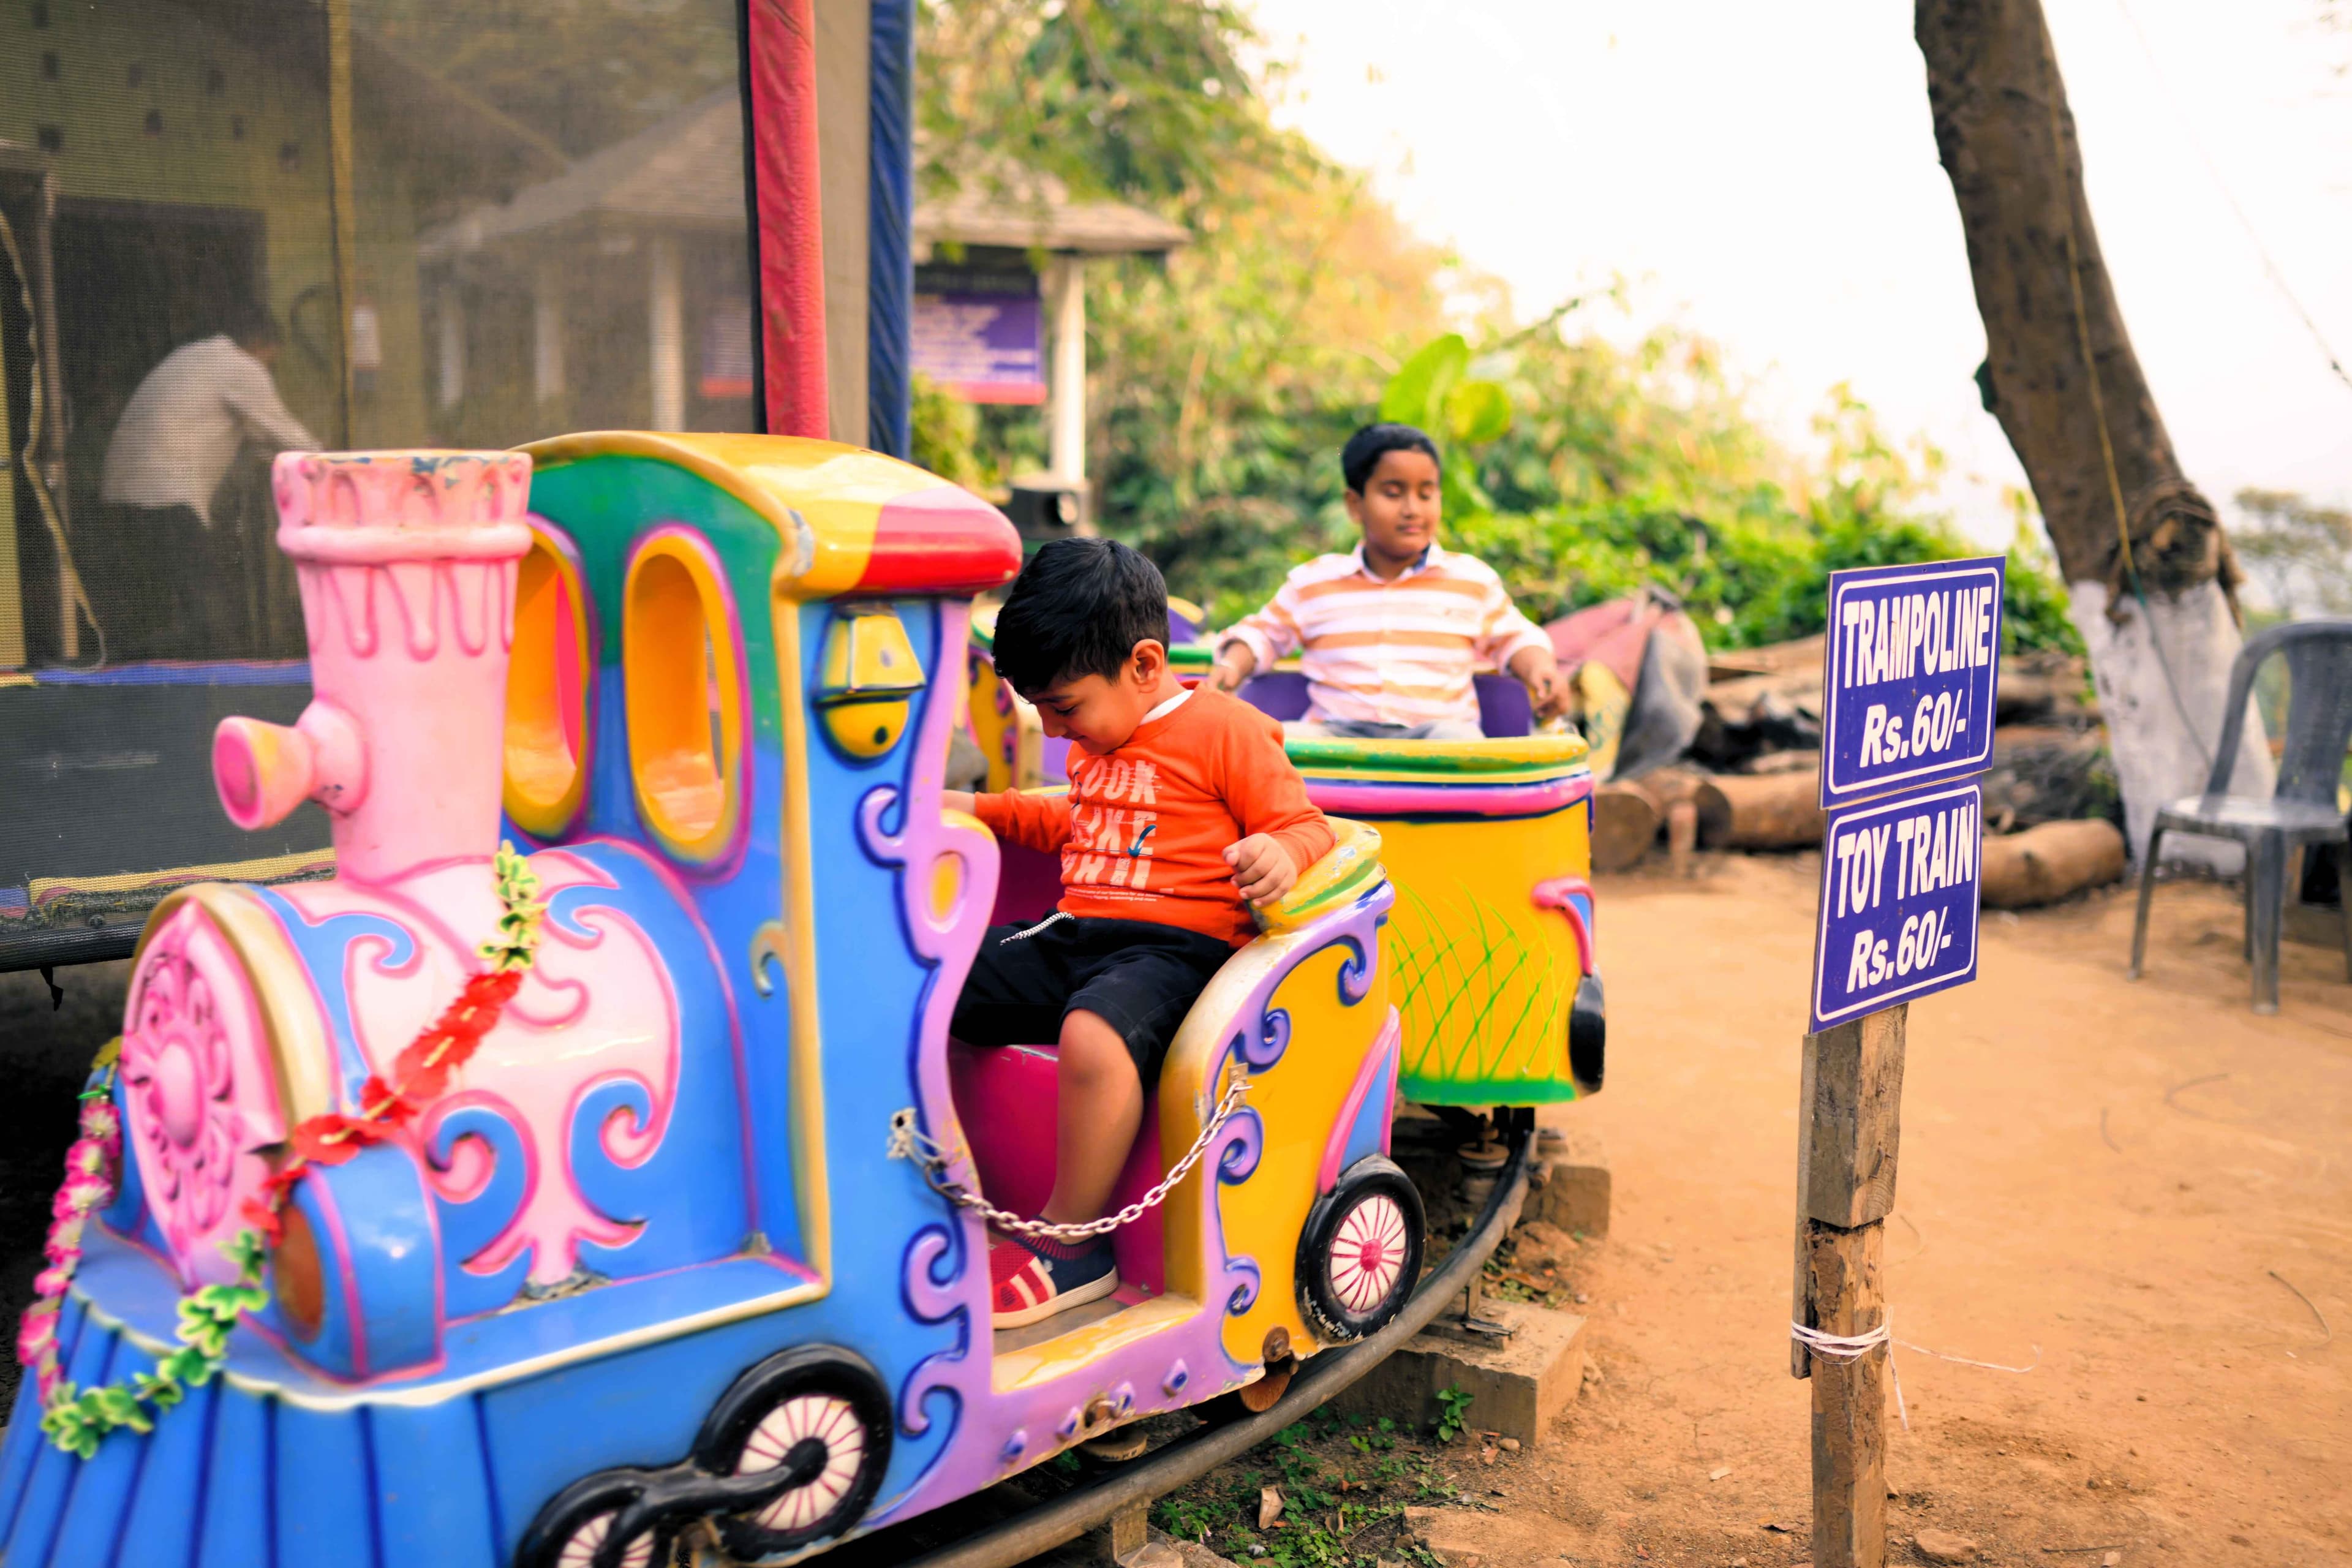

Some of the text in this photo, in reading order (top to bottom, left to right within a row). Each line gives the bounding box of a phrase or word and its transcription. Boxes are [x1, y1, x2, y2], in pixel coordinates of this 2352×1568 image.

[1842, 586, 1992, 688] TRAMPOLINE
[1860, 689, 1966, 768] Rs.60/-
[1837, 804, 1975, 919] TOY TRAIN
[1846, 905, 1951, 993] Rs.60/-
